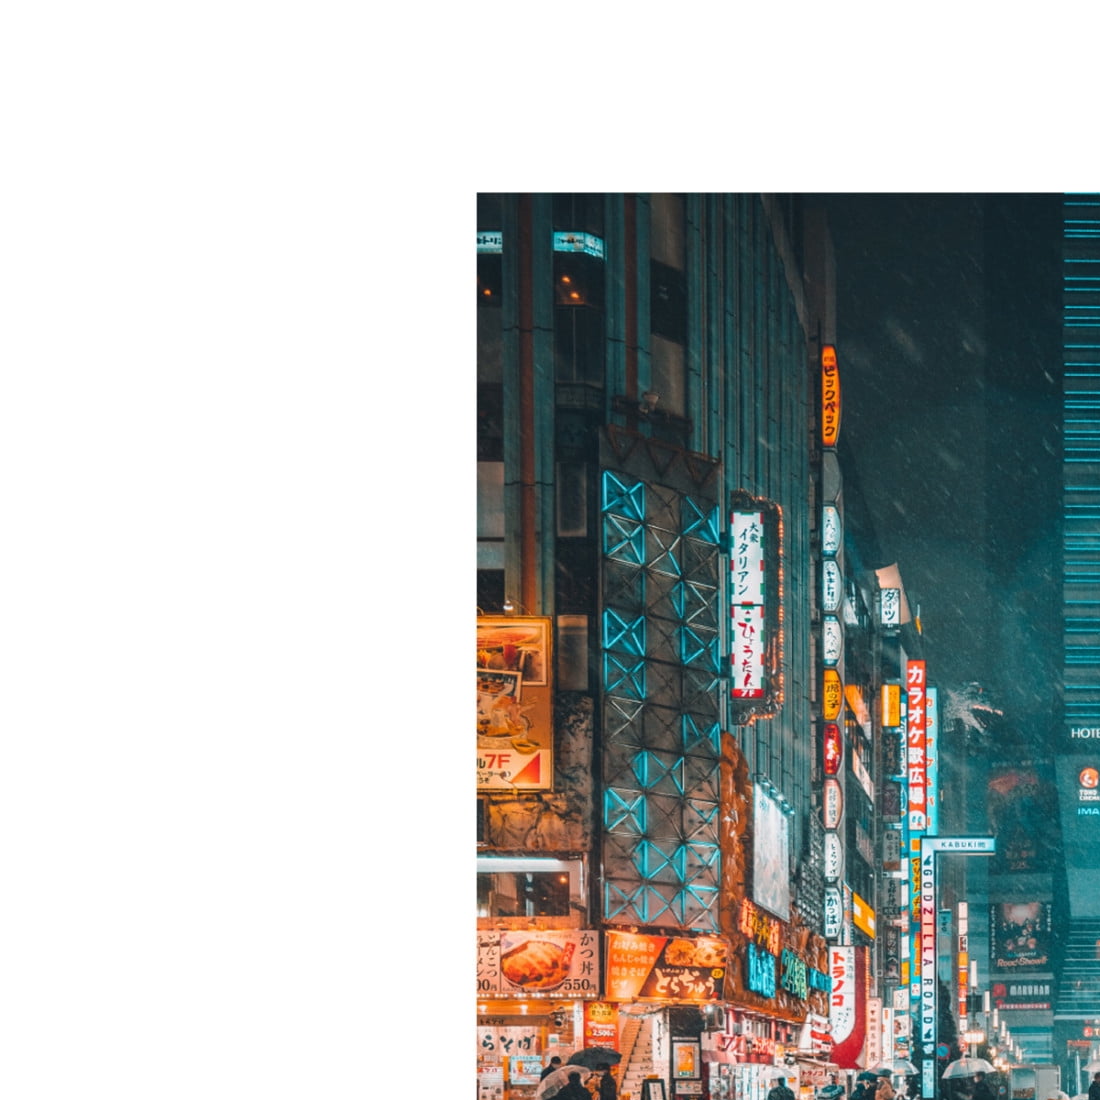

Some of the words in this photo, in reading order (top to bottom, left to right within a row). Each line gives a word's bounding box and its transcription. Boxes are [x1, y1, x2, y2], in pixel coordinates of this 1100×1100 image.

[737, 528, 749, 596] イタリアン
[908, 665, 925, 805] カラオケ歌広場
[923, 869, 933, 966] GODZILLA
[580, 933, 594, 975] かつ丼
[832, 951, 846, 1007] トラノコ
[923, 978, 934, 1025] ROAD
